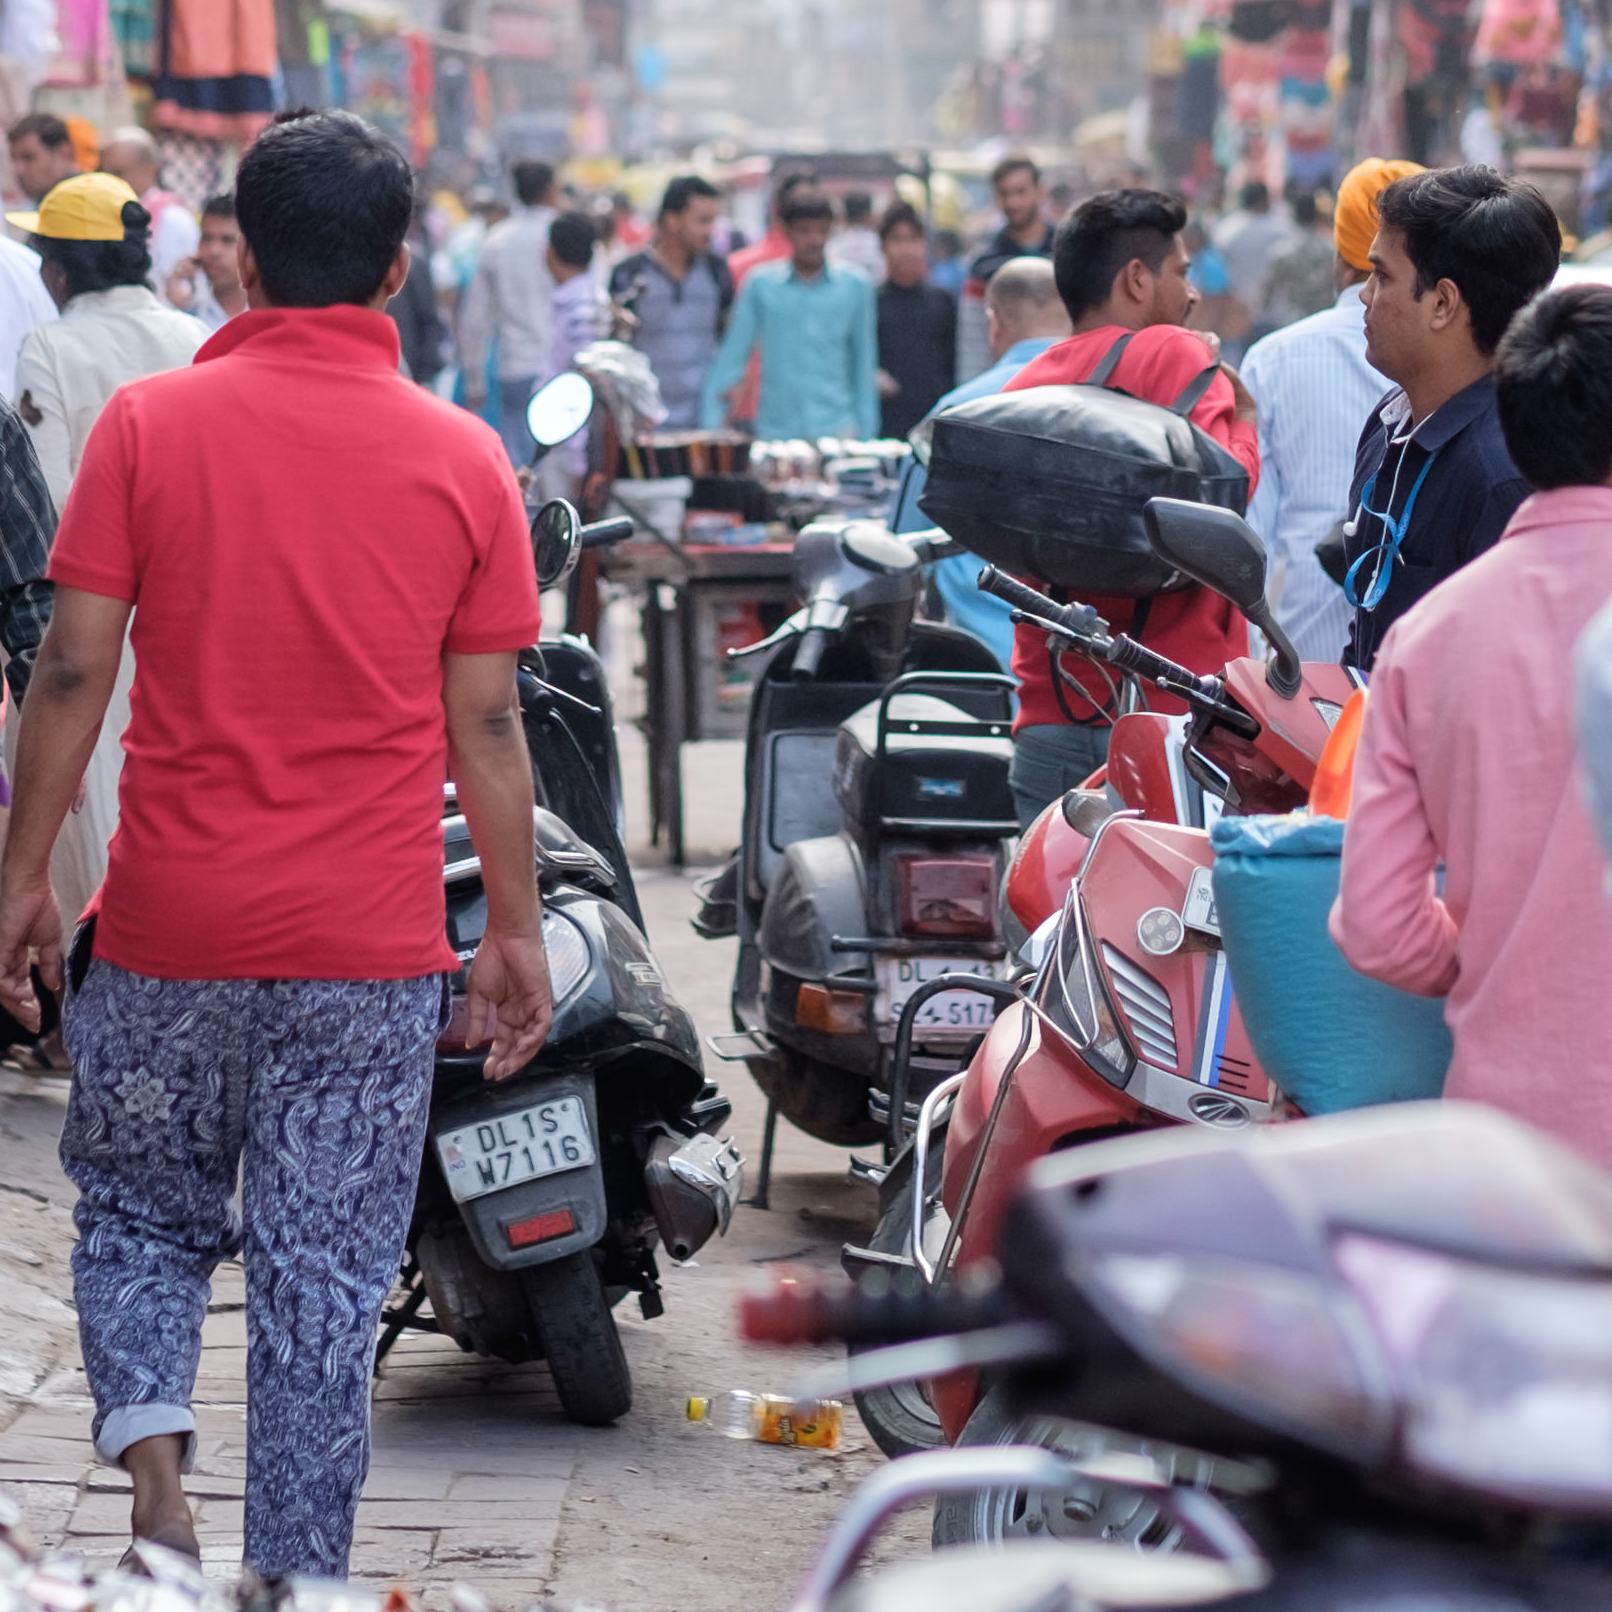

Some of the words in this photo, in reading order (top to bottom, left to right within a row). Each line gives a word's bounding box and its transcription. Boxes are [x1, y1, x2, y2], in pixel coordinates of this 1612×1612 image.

[898, 961, 928, 983] DL
[948, 1002, 996, 1025] 517
[475, 1134, 581, 1186] W7116
